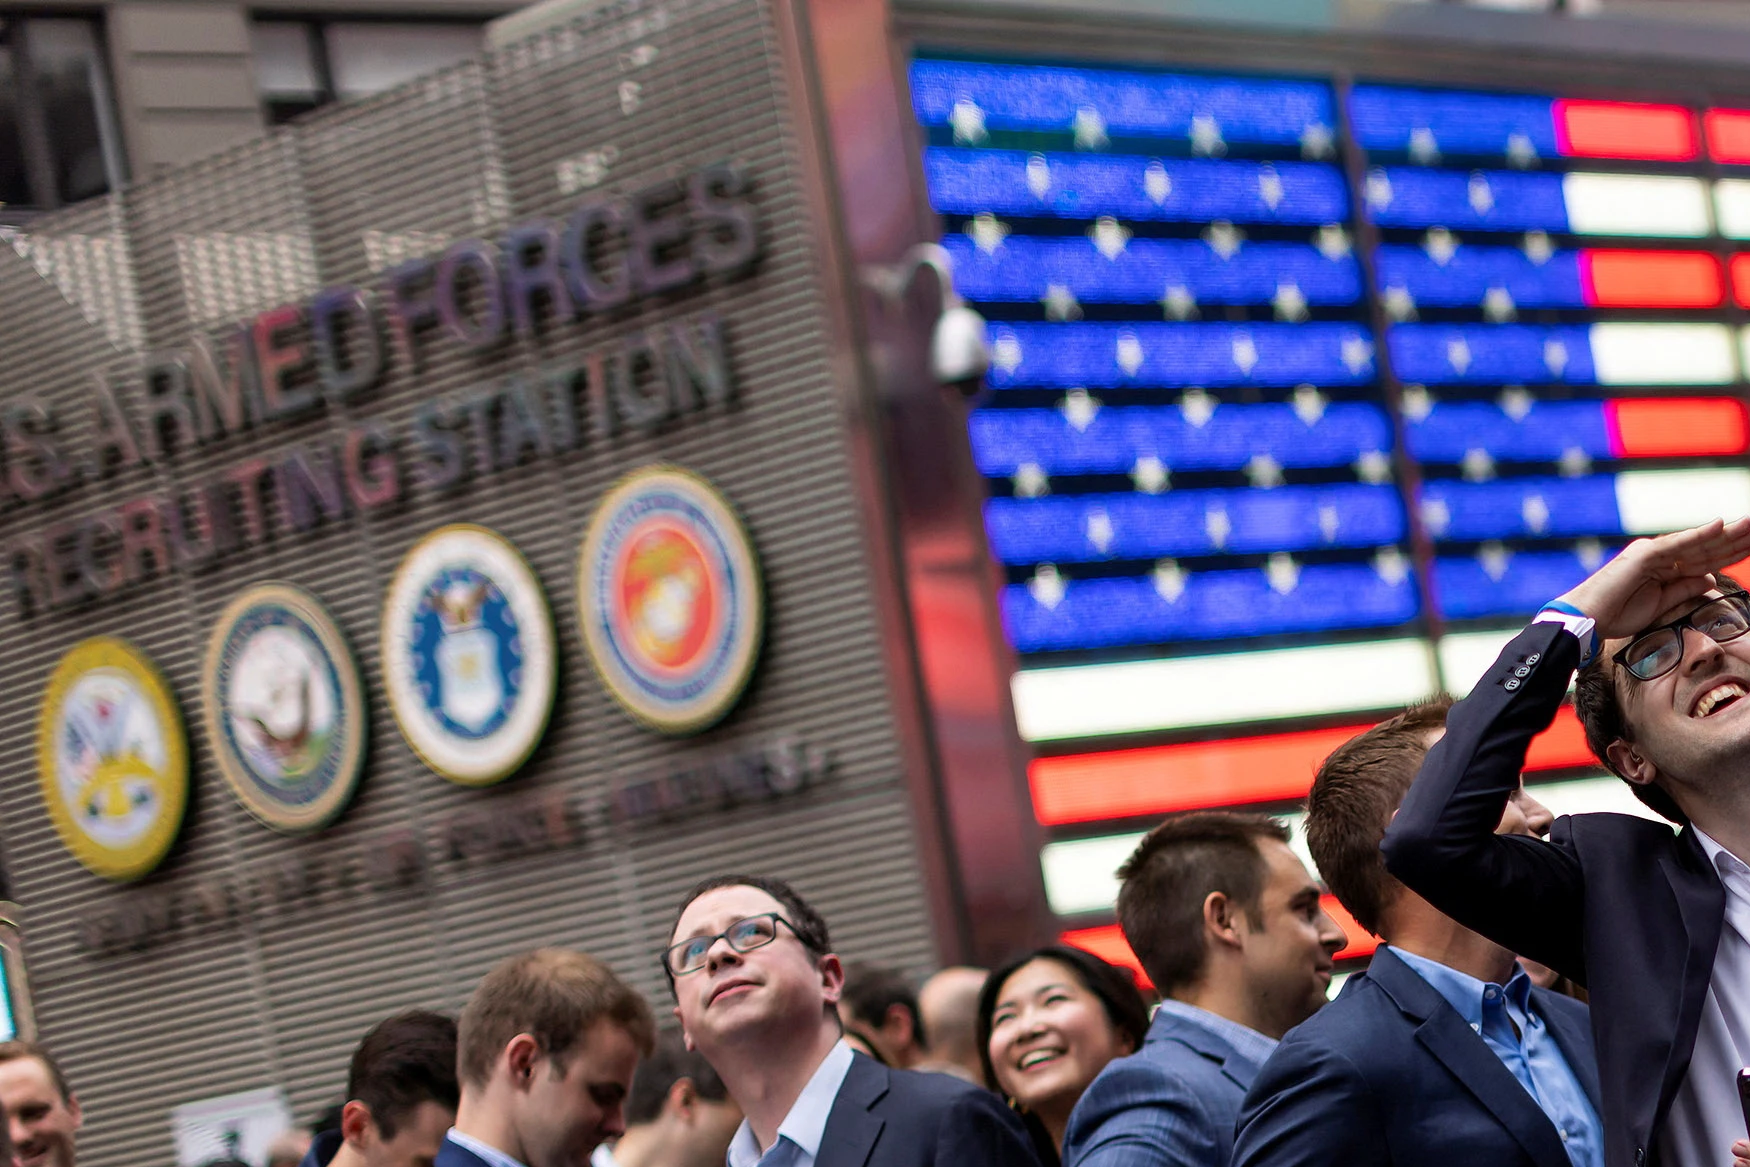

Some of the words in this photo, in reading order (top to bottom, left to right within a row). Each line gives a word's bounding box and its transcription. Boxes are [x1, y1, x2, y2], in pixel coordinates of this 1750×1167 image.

[8, 421, 400, 608] RECRUITING
[412, 312, 724, 488] STATION
[88, 286, 384, 474] ARMED
[390, 162, 754, 364] FORCES
